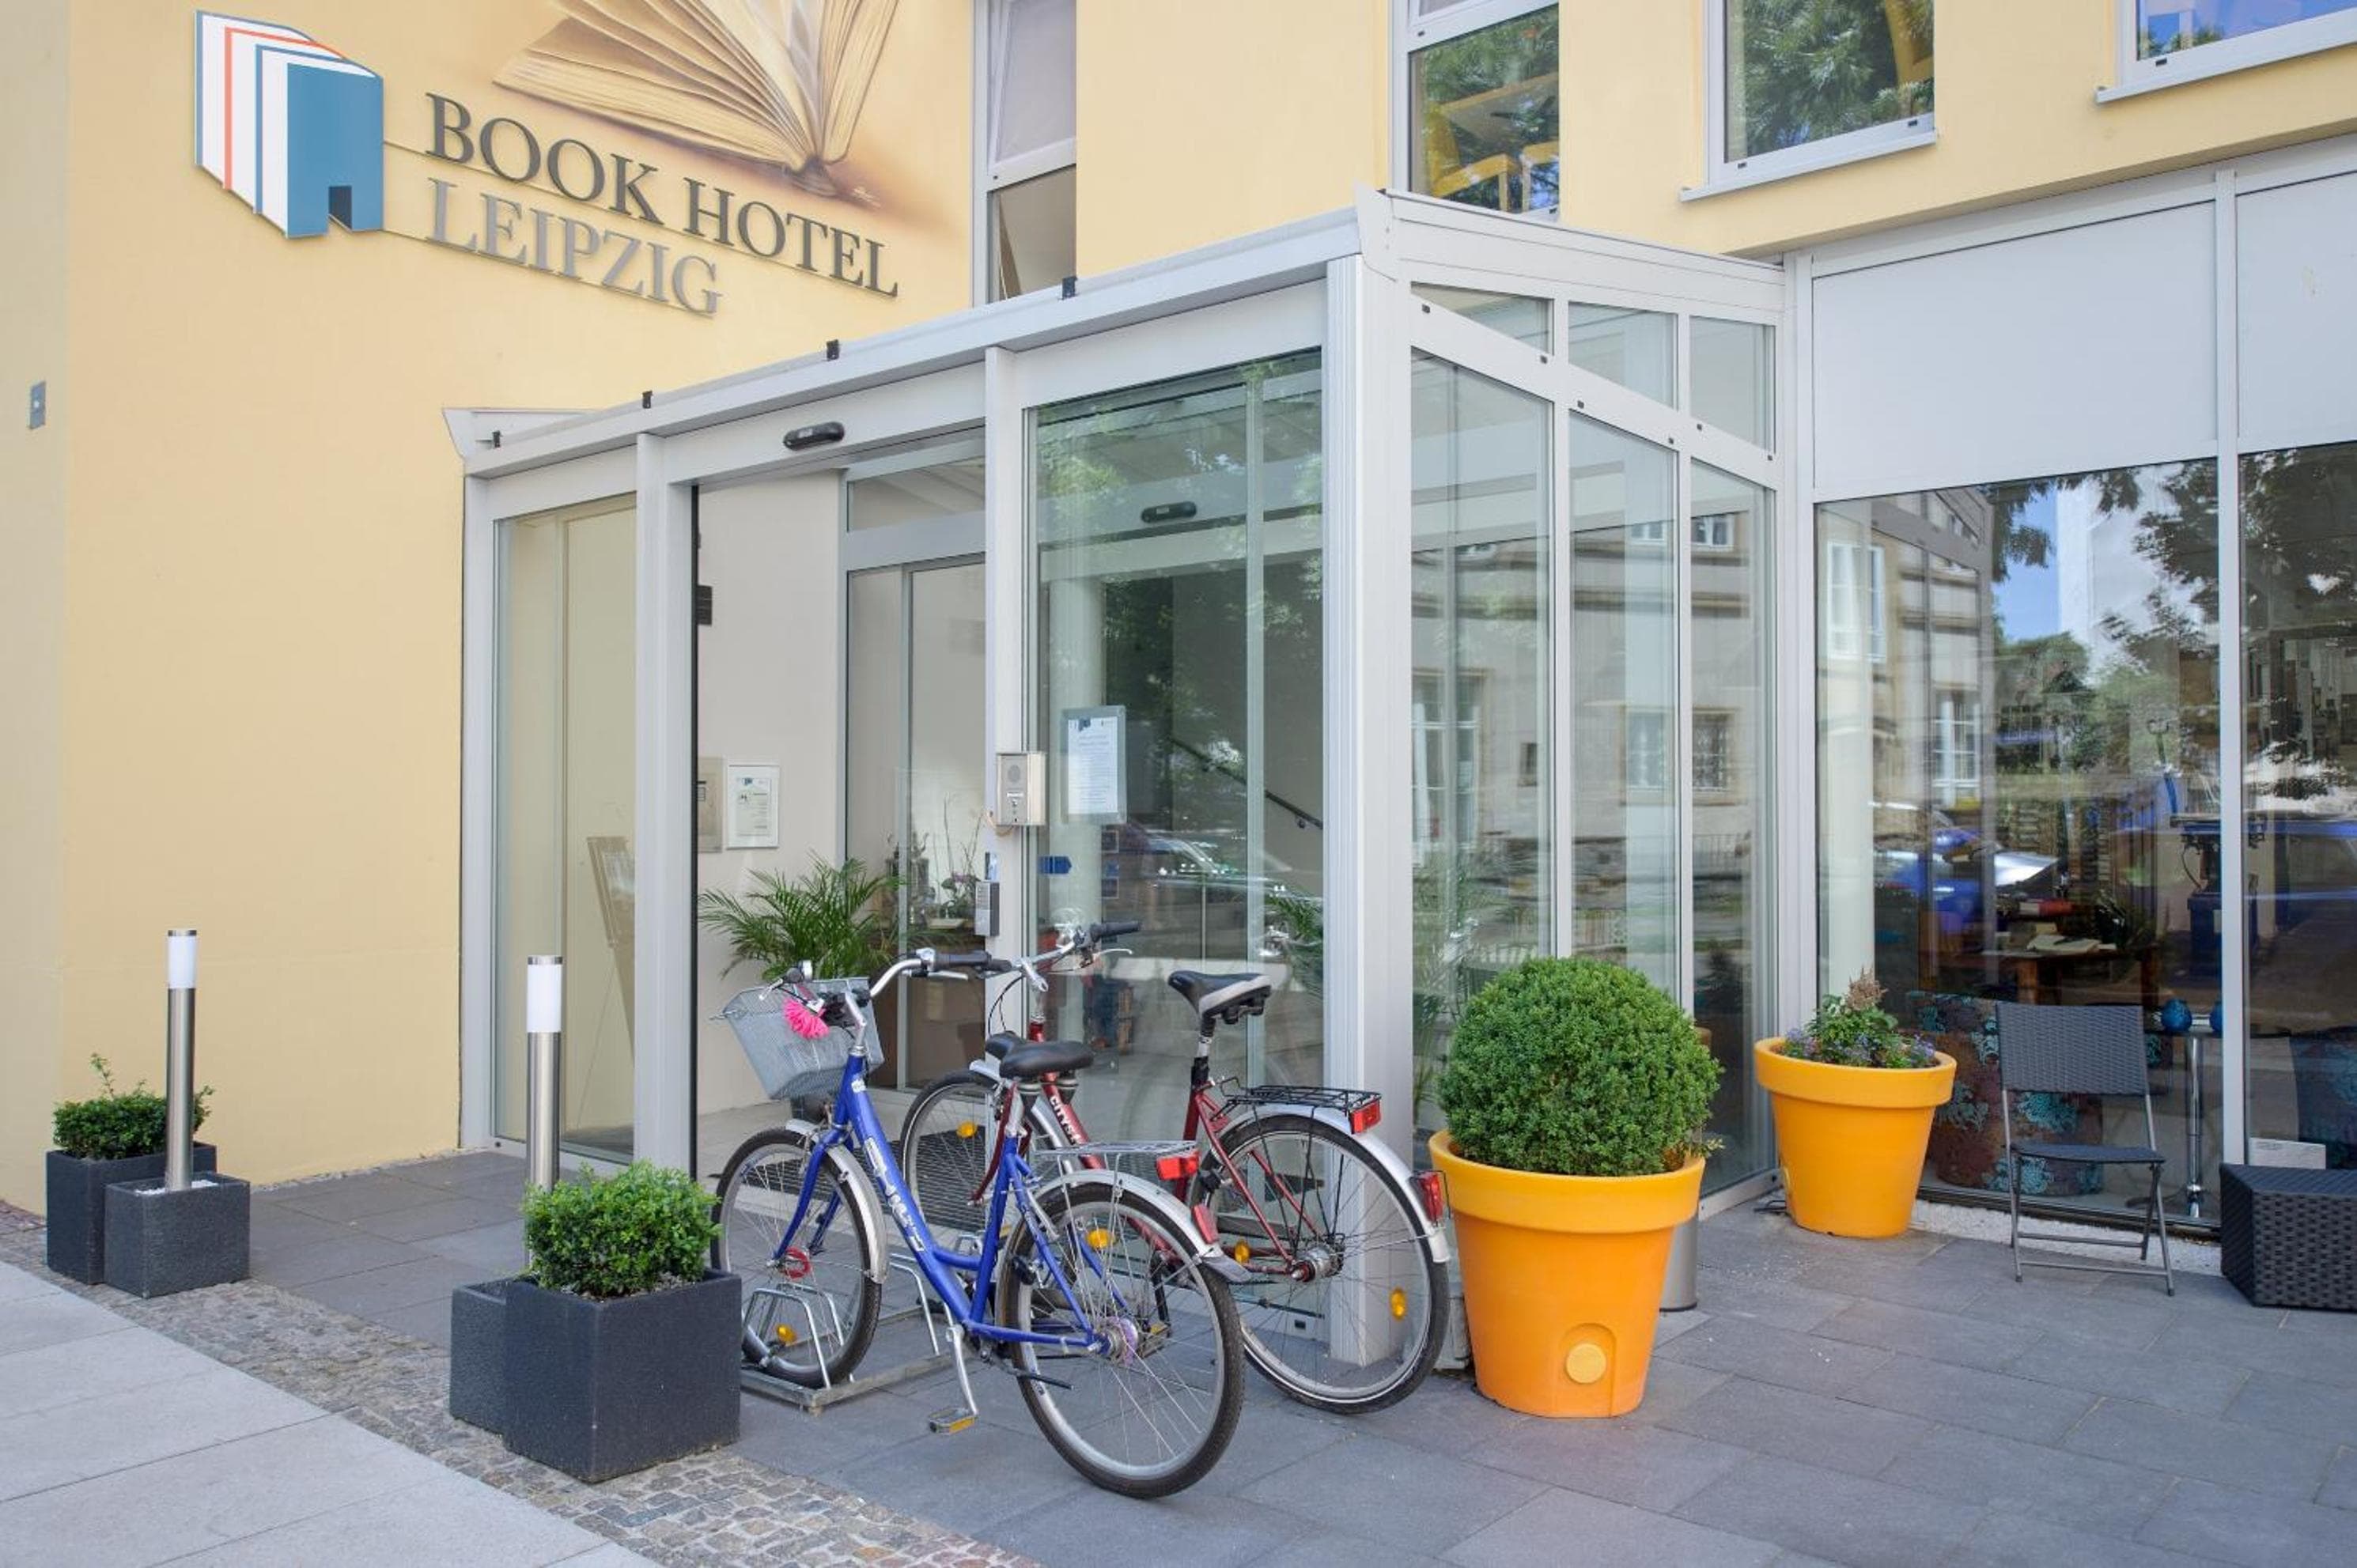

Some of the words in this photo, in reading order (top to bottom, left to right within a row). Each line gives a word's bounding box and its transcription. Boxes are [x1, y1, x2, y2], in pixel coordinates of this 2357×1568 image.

[424, 176, 724, 314] LEIPZIG
[425, 91, 664, 226] BOOK
[683, 176, 899, 297] HOTEL
